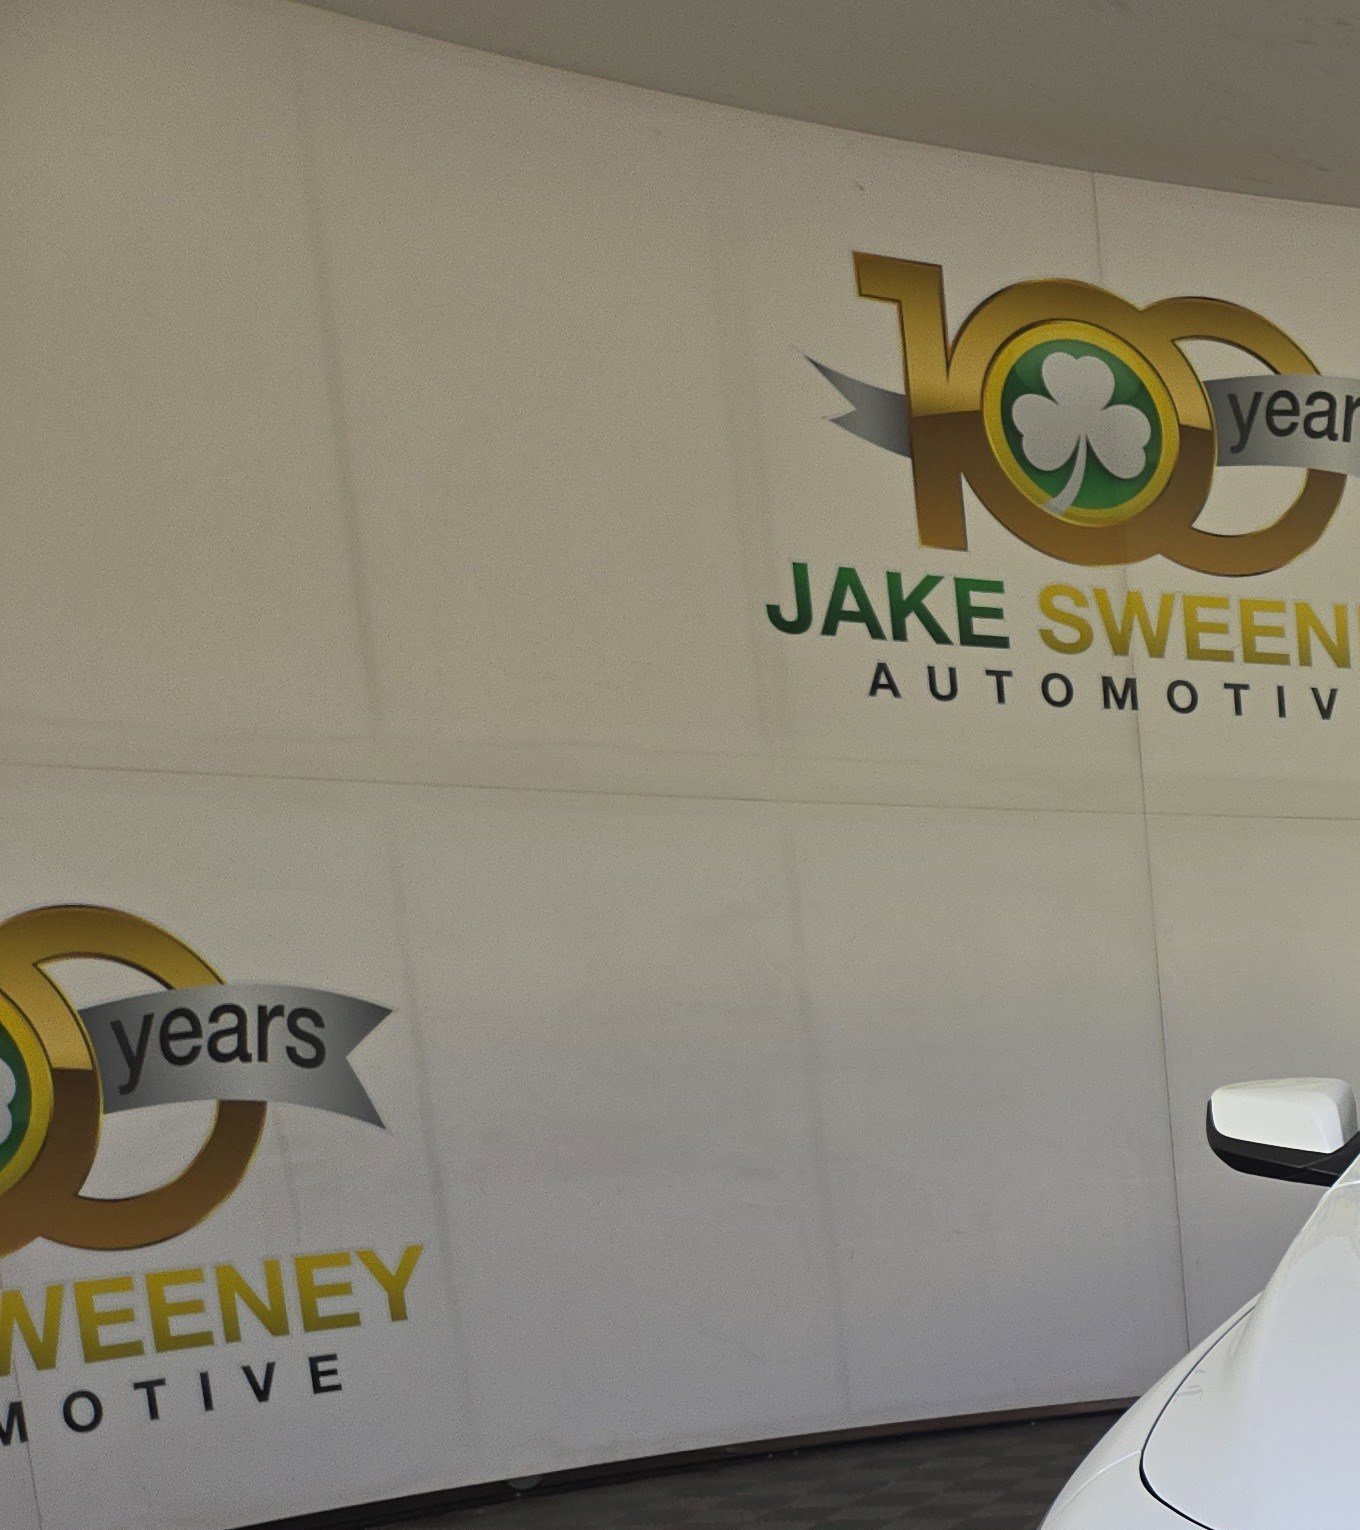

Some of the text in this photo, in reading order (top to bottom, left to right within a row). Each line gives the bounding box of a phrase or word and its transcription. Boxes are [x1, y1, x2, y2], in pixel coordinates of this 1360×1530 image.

[852, 250, 1346, 577] 100
[765, 561, 1011, 650] JAKE
[110, 1002, 326, 1095] years
